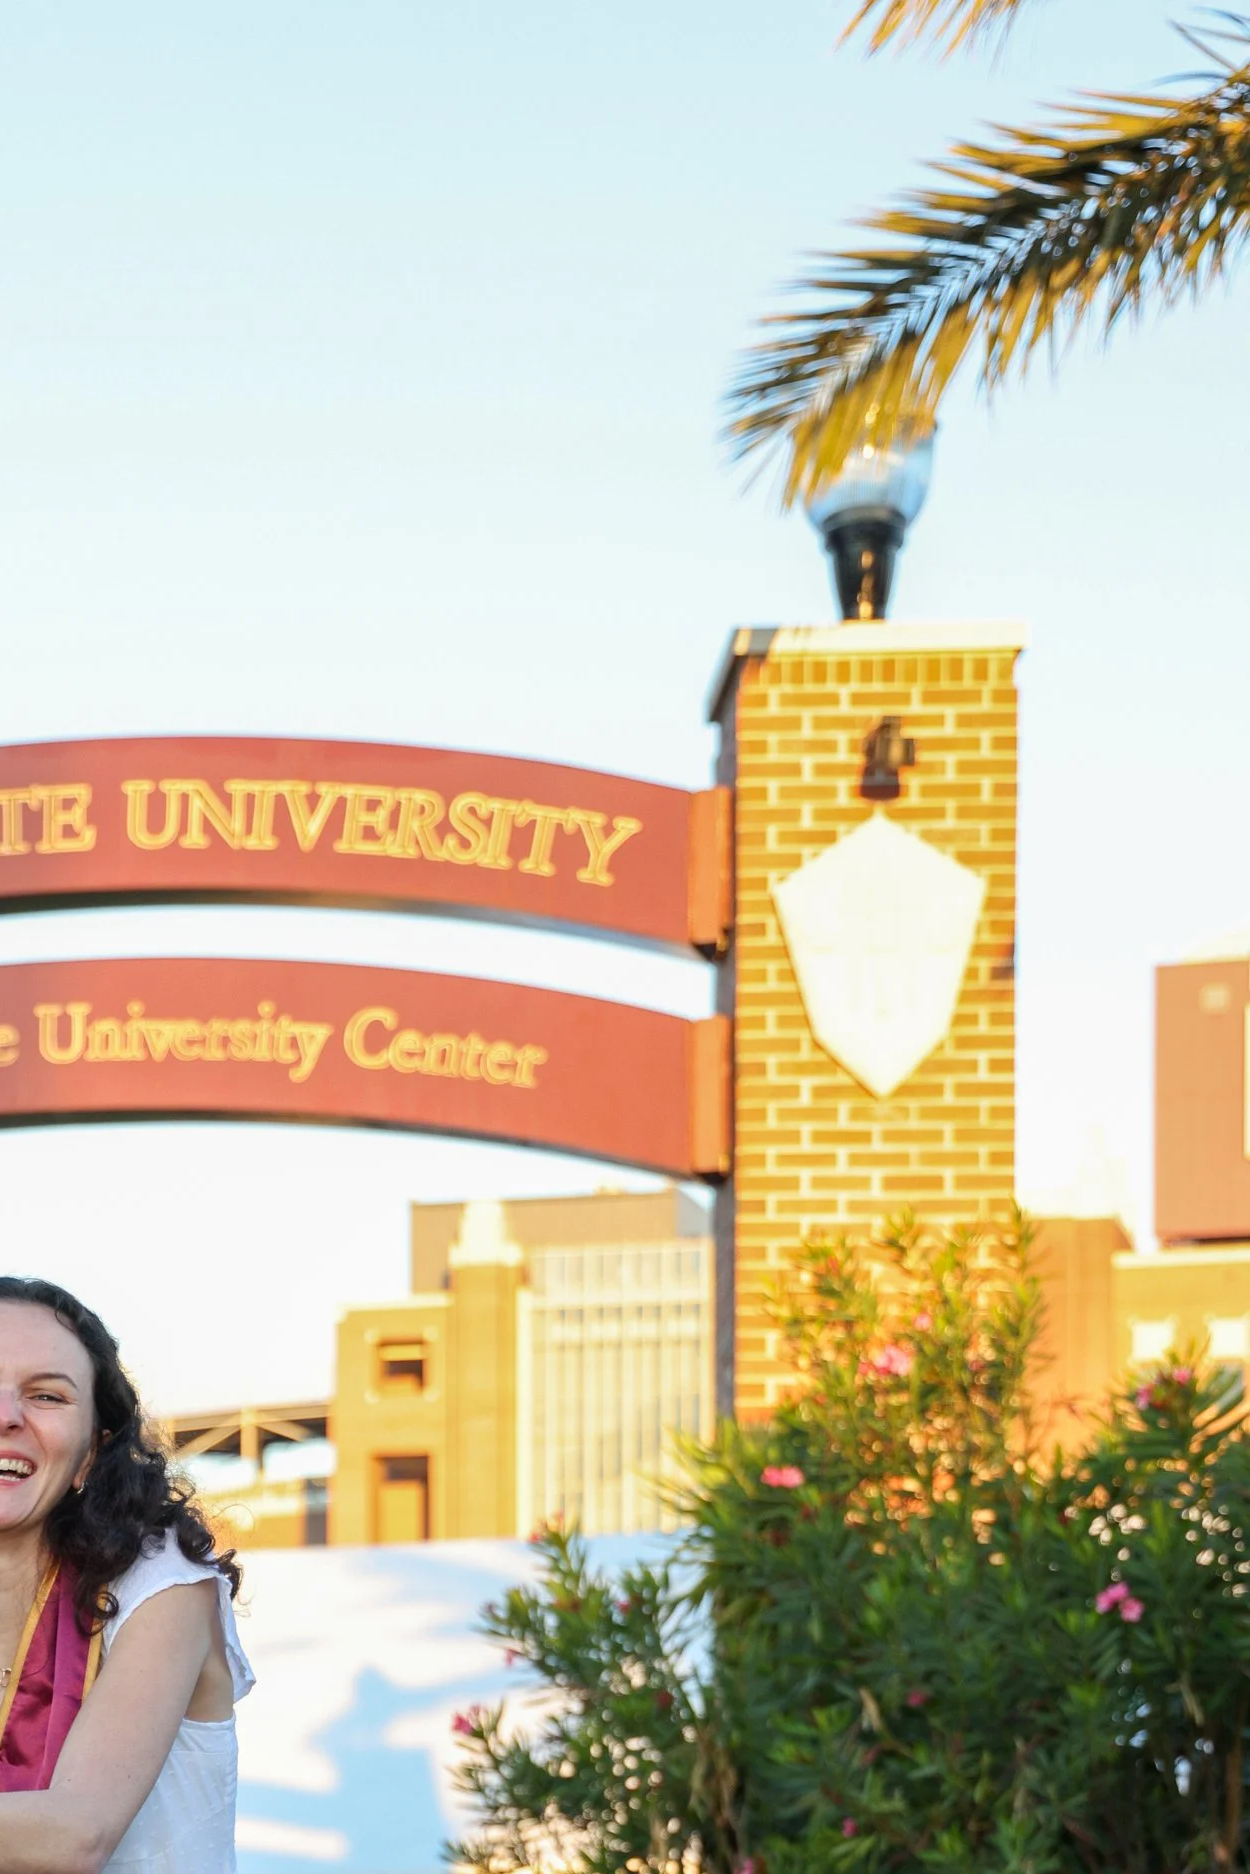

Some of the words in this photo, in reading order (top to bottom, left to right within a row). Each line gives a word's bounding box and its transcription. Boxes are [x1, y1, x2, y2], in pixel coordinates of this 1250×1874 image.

[121, 779, 642, 886] UNIVERSITY
[33, 1000, 334, 1083] University
[344, 1007, 548, 1089] Center
